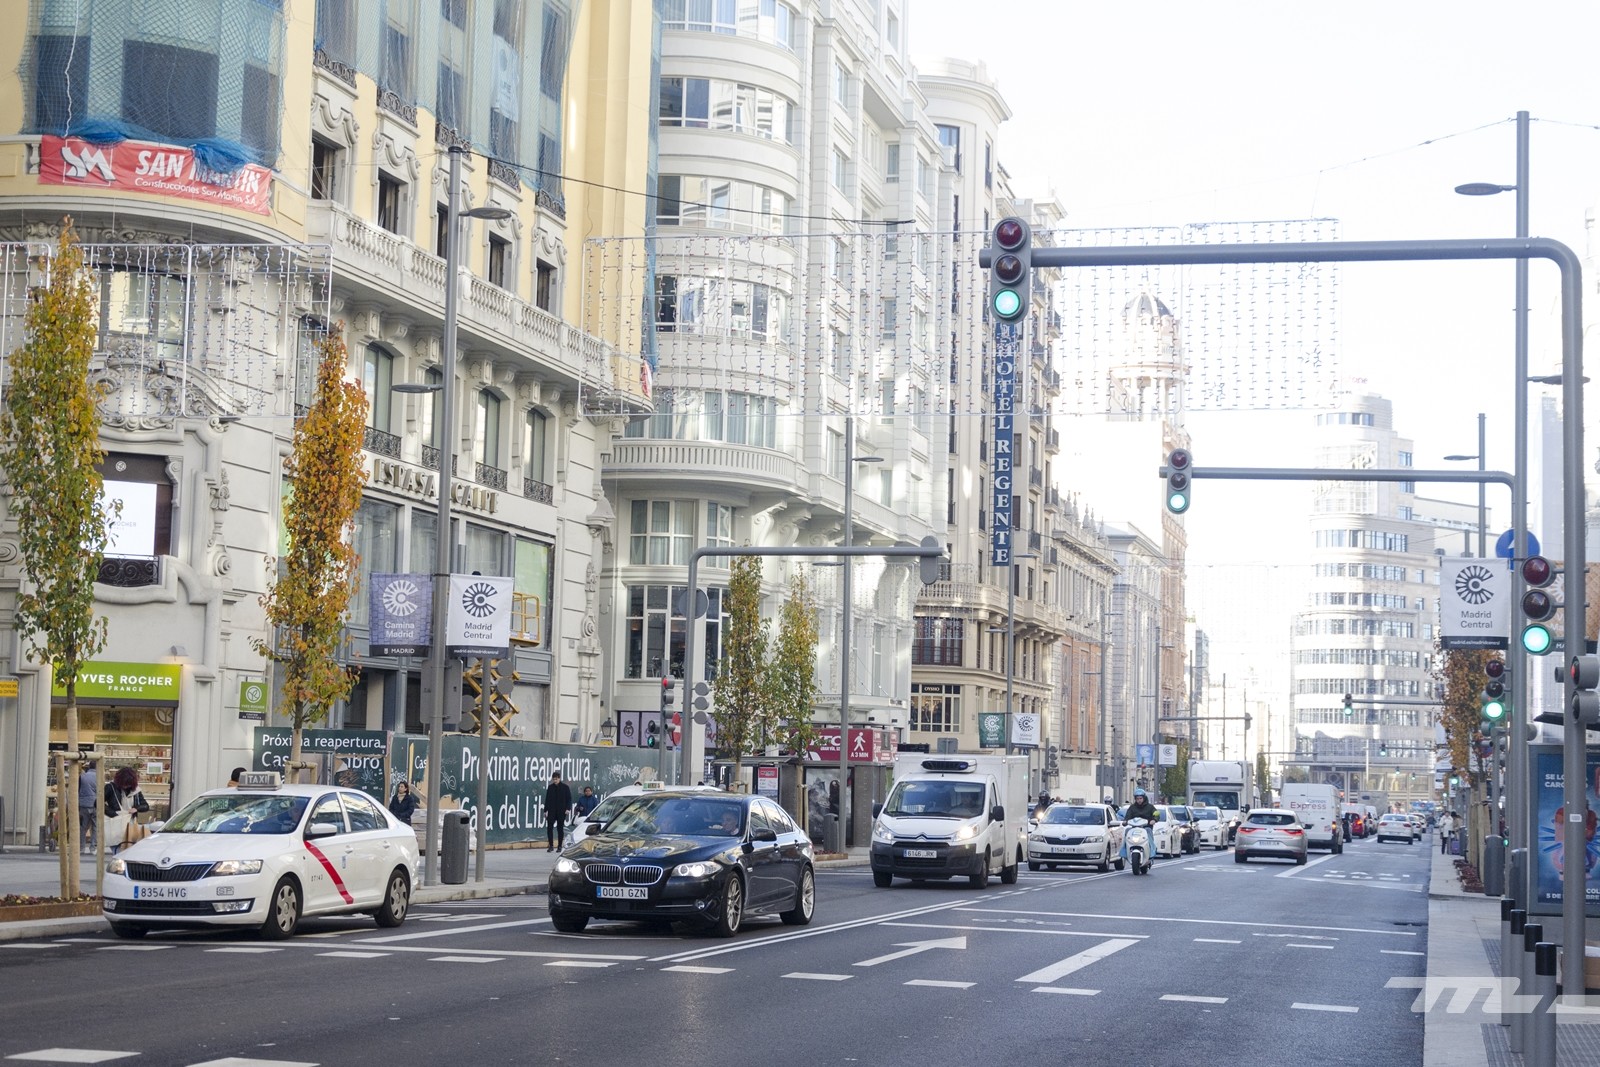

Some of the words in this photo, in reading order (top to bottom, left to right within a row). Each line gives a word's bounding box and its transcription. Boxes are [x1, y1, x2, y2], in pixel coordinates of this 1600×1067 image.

[135, 150, 185, 178] SAN
[134, 177, 200, 195] Construcciones
[201, 187, 218, 198] San
[374, 459, 437, 498] ESPASA
[995, 439, 1011, 564] REGENTE
[1460, 611, 1492, 619] Madrid
[384, 621, 415, 630] Camina
[464, 622, 493, 631] Madrid
[1460, 620, 1493, 629] Central
[385, 630, 414, 638] Madrid
[463, 631, 493, 640] Central
[81, 674, 114, 684] YVES
[119, 675, 173, 686] ROCHER
[262, 734, 310, 747] Próxia
[524, 753, 591, 787] reapertura
[248, 774, 269, 784] TAXI
[1290, 802, 1327, 810] Express
[499, 795, 521, 830] del
[140, 887, 165, 898] 8354
[167, 888, 187, 898] HVG
[602, 887, 624, 896] 0001
[627, 888, 646, 897] GZN
